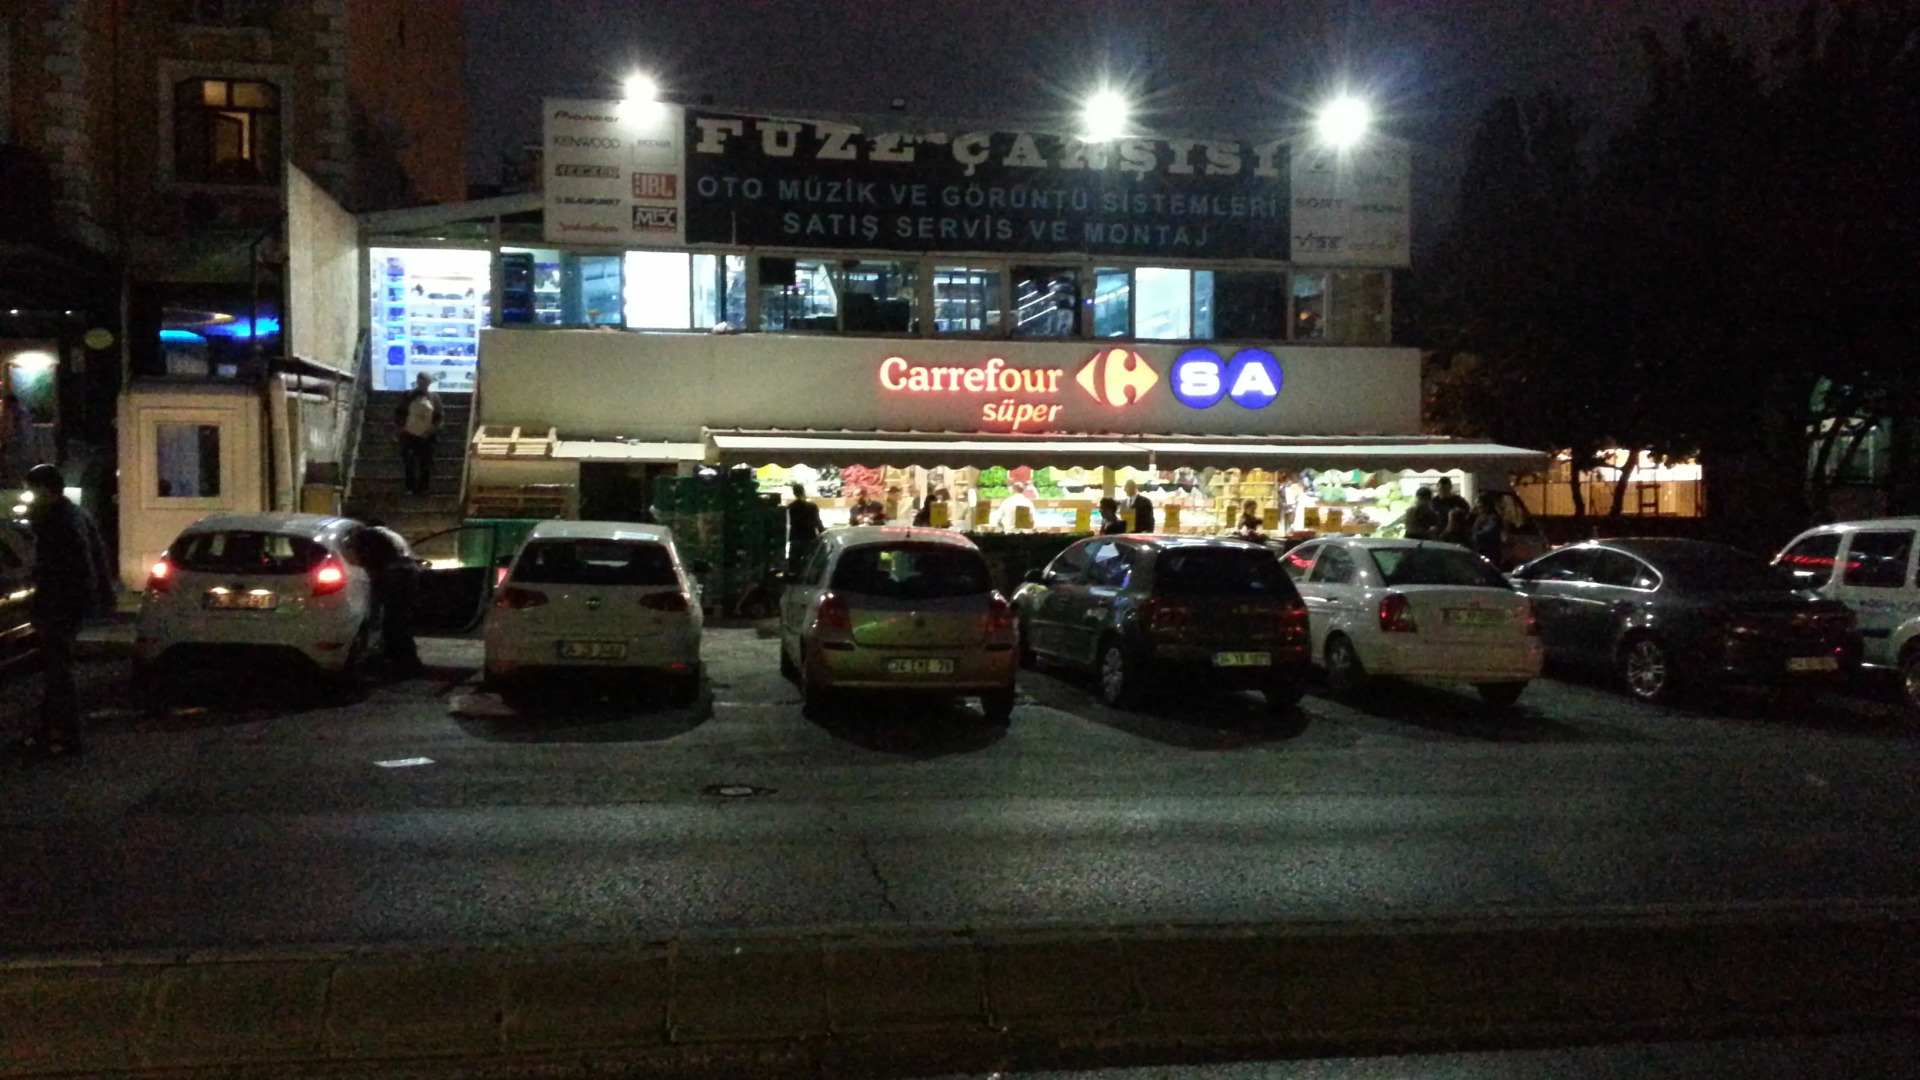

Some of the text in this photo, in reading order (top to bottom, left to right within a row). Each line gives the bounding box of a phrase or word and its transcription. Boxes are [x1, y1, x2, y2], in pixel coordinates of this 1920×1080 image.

[553, 135, 620, 149] KENWOOD
[635, 174, 674, 197] JBL
[697, 176, 763, 199] OTO
[778, 175, 876, 204] MÜZİK
[890, 183, 927, 206] VE
[783, 212, 1209, 247] SATIŞ SERVİS VE MONTAJ
[879, 356, 1063, 394] Carrefour
[981, 399, 1063, 430] süper
